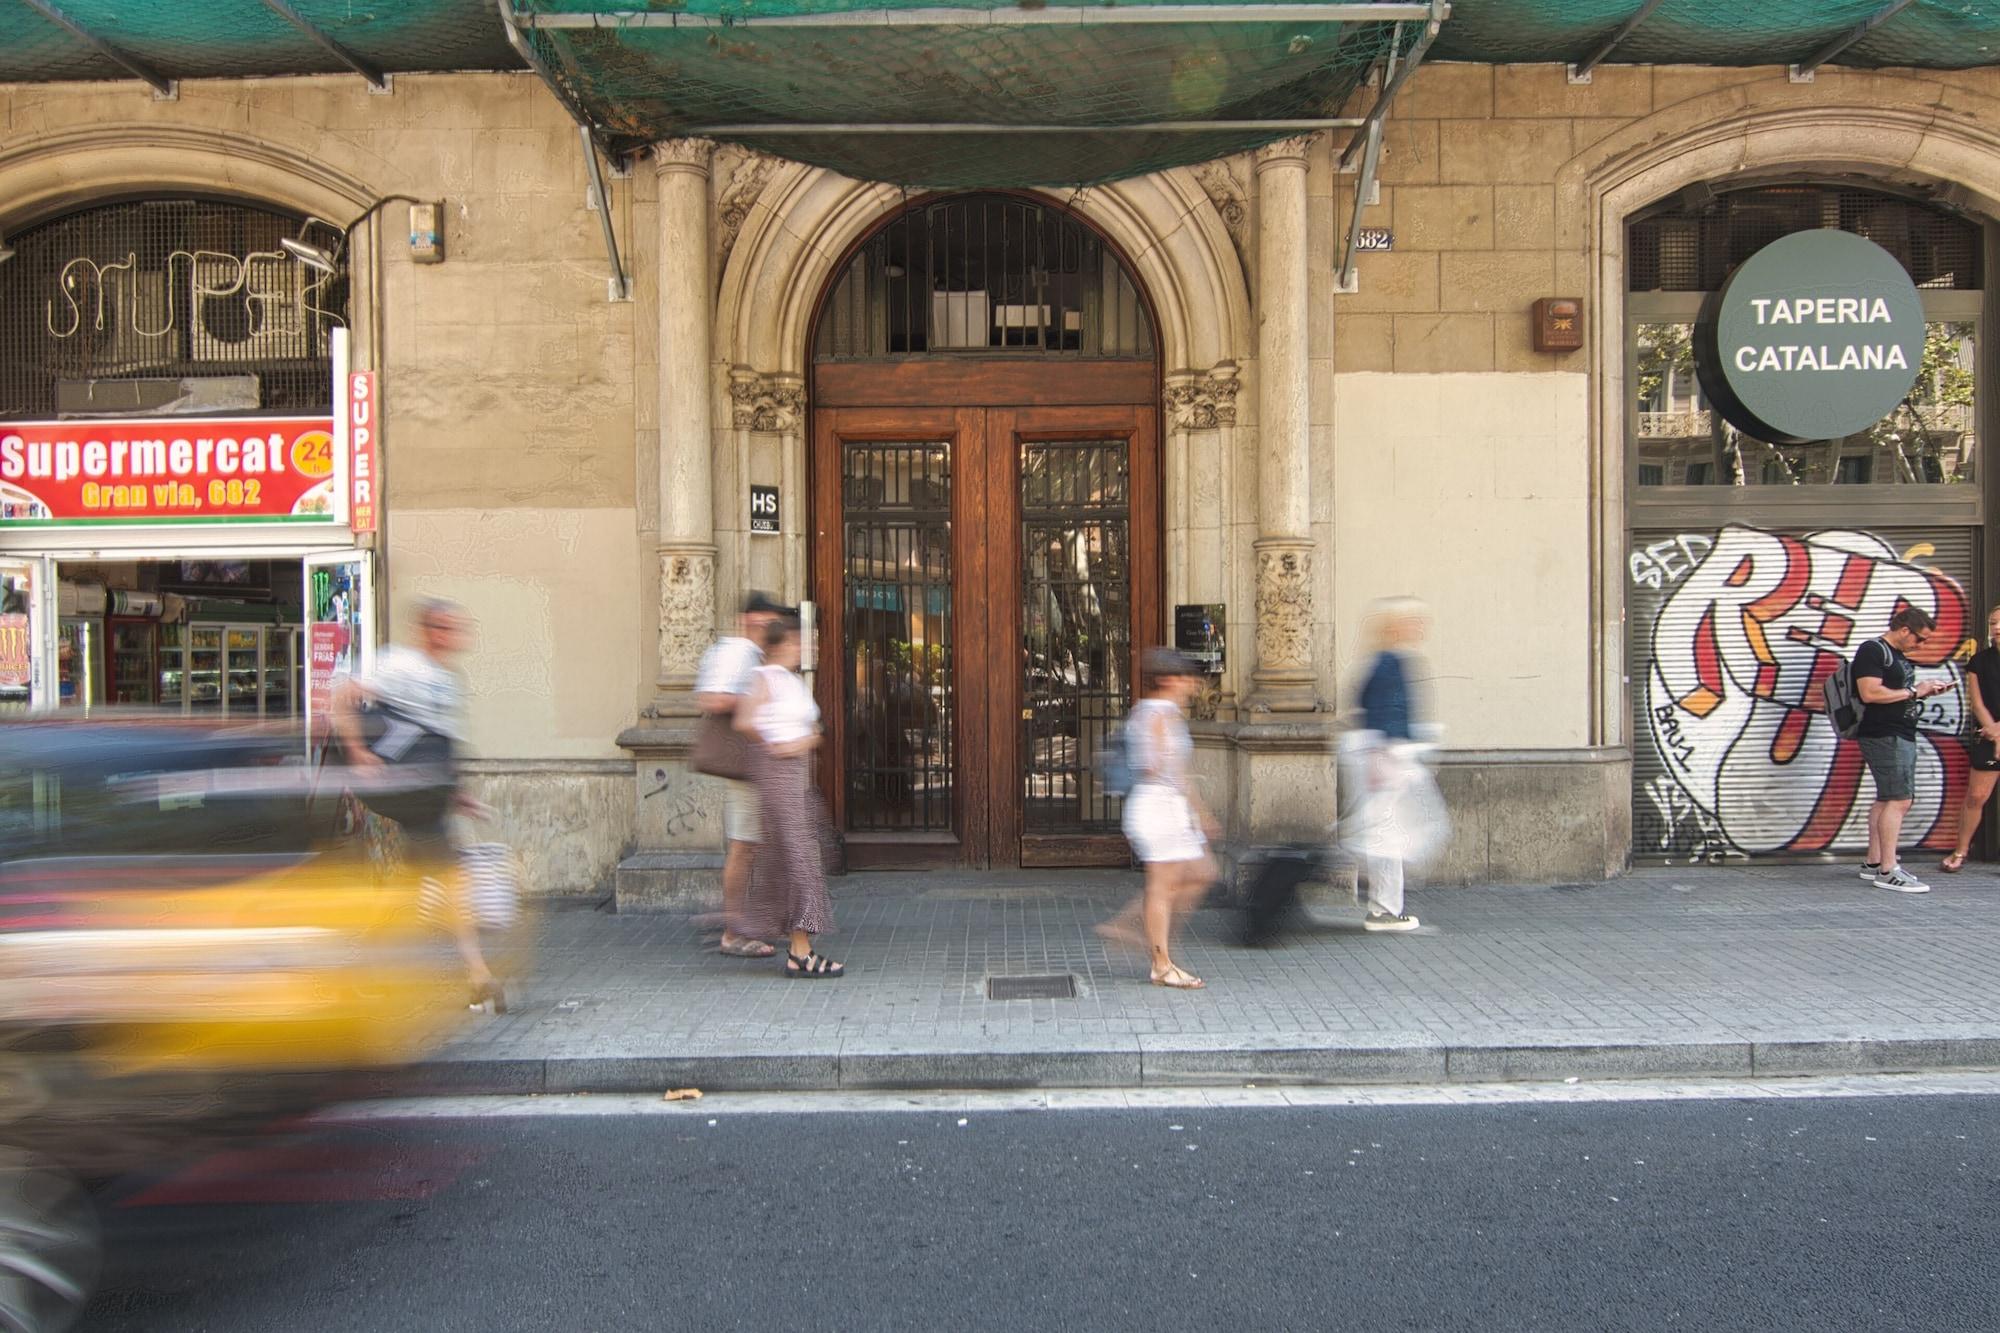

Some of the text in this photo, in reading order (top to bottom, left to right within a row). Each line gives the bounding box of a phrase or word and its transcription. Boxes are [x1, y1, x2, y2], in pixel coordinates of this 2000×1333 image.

[1356, 230, 1389, 249] 682
[1751, 298, 1892, 325] TAPERIA
[1735, 345, 1908, 371] CATALANA
[302, 440, 333, 461] 24
[353, 375, 370, 503] SUPER
[1, 433, 285, 481] Supermercat
[82, 482, 147, 508] Gran
[208, 479, 261, 506] 682
[752, 492, 777, 513] HS
